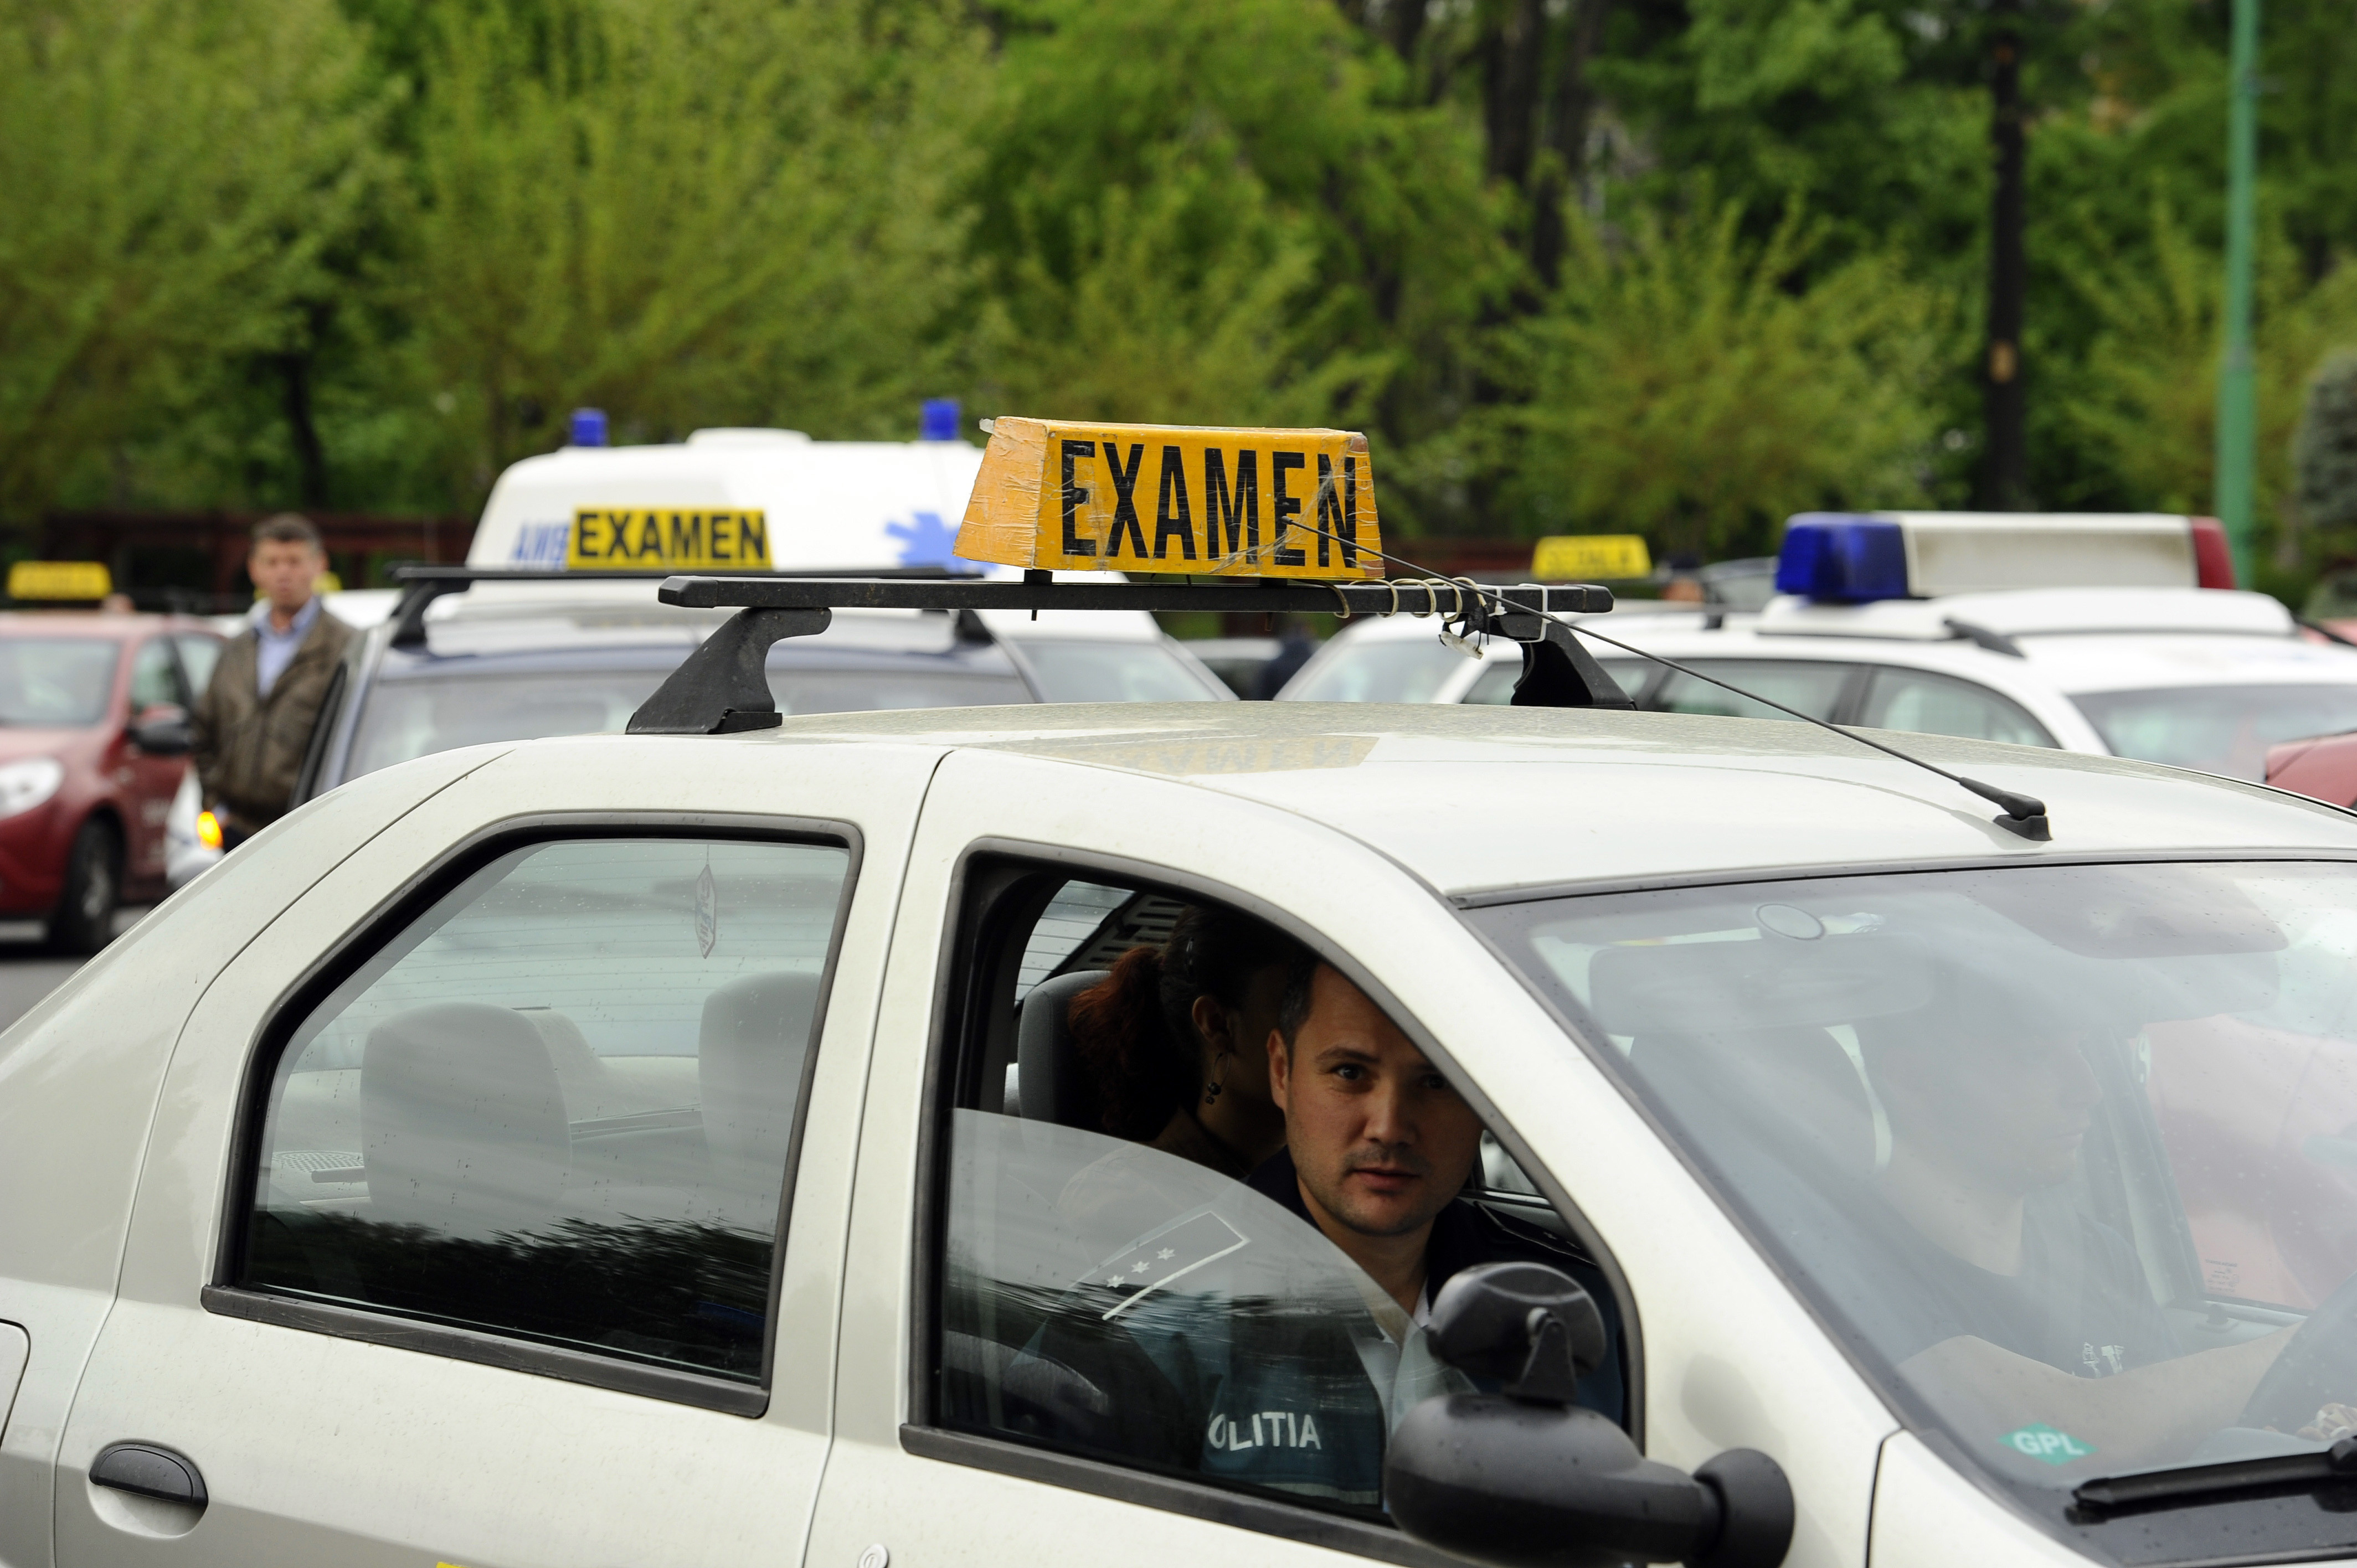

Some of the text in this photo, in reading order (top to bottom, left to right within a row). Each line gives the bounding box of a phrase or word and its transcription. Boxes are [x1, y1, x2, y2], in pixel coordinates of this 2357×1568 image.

[1062, 440, 1356, 569] EXAMEN
[578, 512, 765, 560] EXAMEN
[1208, 1411, 1322, 1451] OLITIA
[2013, 1431, 2085, 1456] GPL
